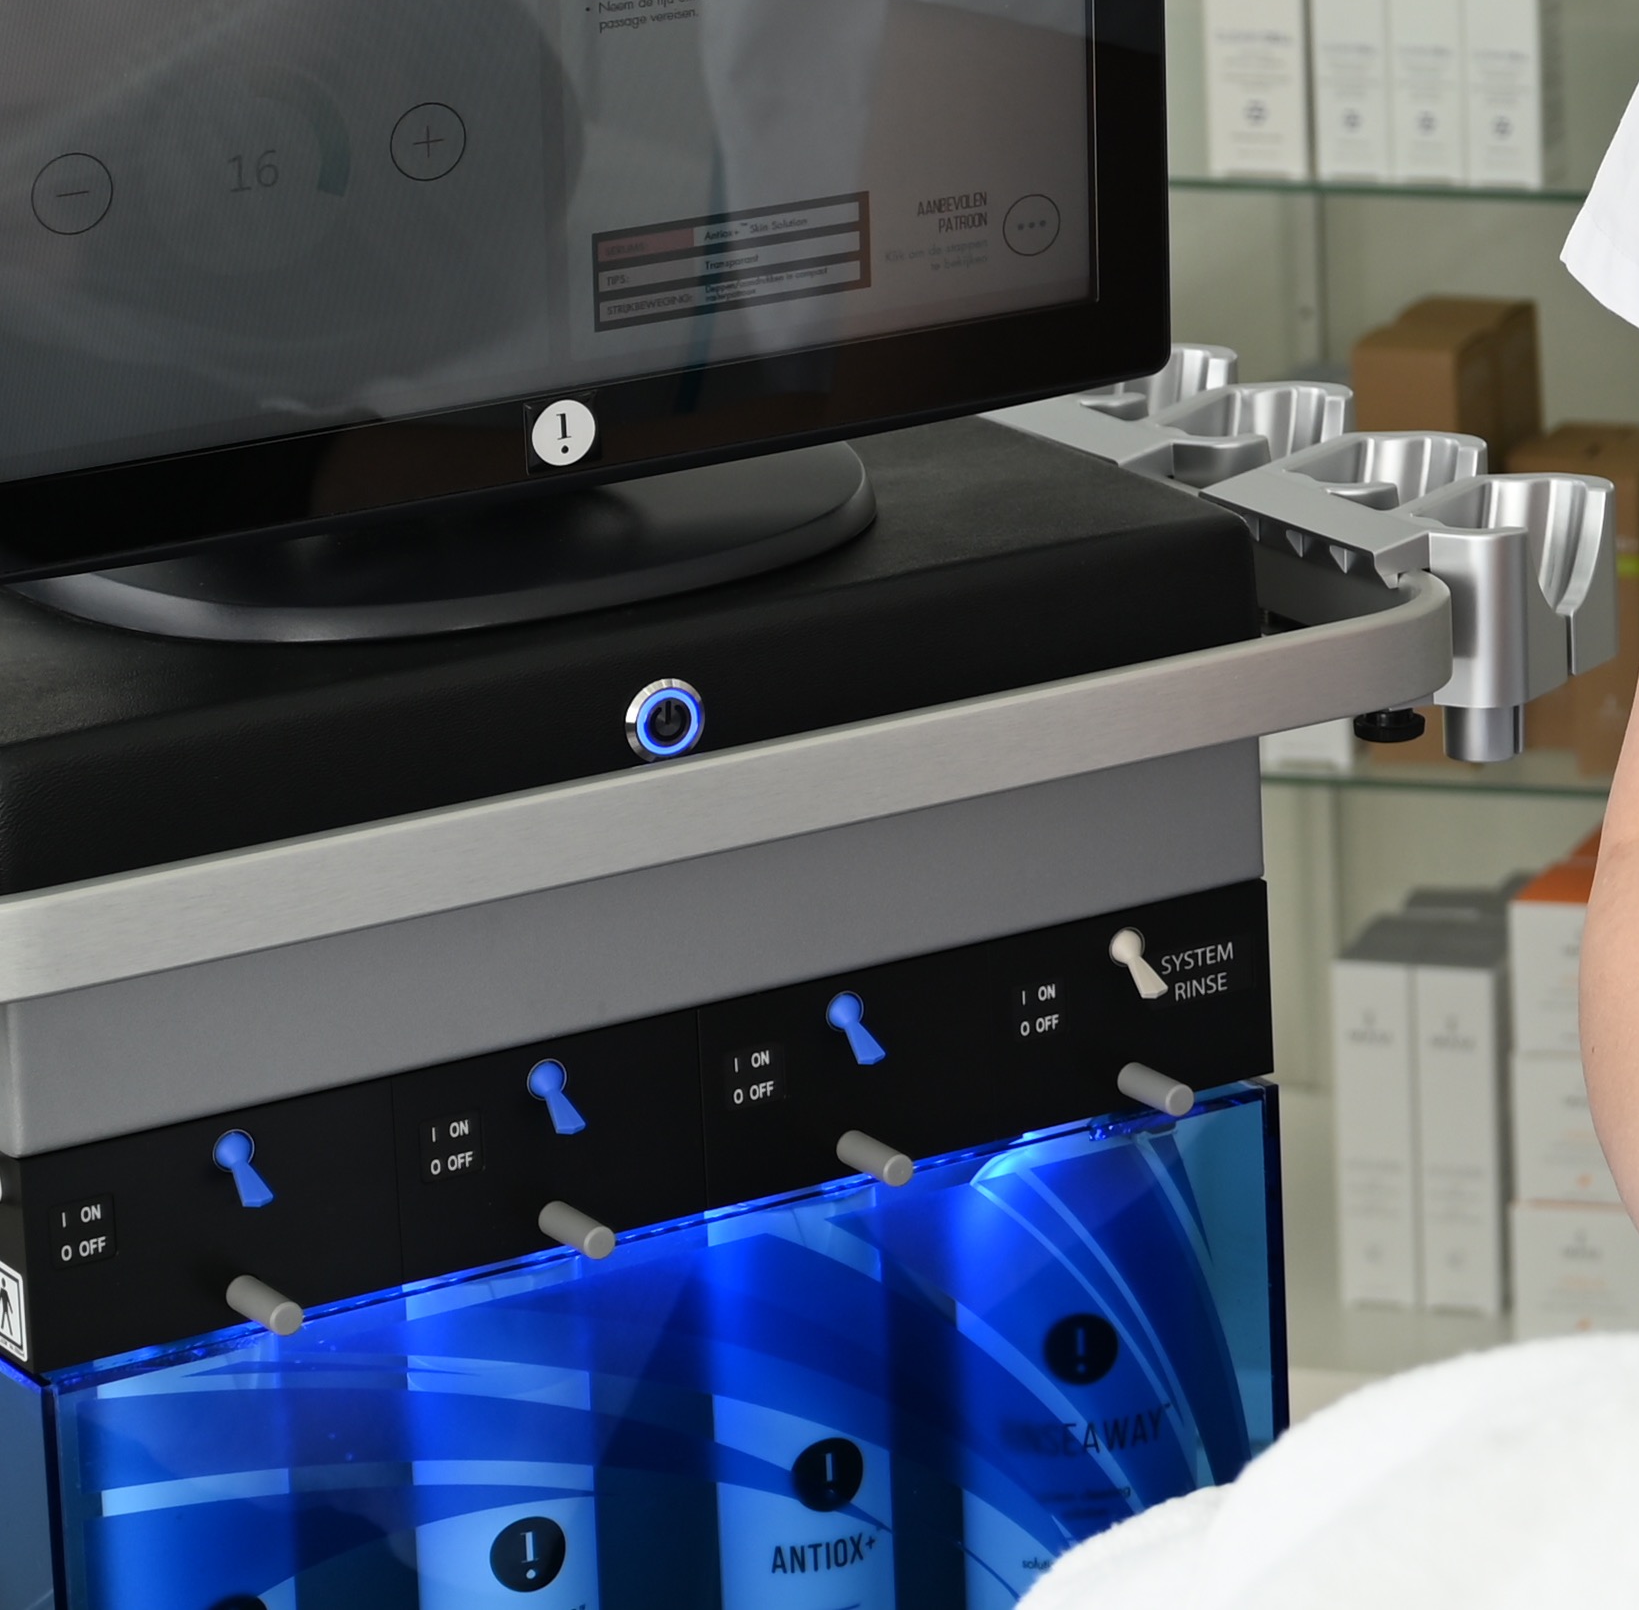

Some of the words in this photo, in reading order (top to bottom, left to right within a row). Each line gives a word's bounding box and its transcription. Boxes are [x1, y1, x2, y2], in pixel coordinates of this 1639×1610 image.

[598, 0, 634, 15] Neem
[599, 16, 647, 33] passage
[228, 149, 280, 193] 16
[917, 192, 988, 217] AANBEVOLEN
[938, 212, 988, 234] PATROON
[1161, 941, 1233, 975] SYSTEM
[1038, 984, 1056, 1001] ON
[1174, 972, 1228, 1001] RINSE
[1035, 1014, 1059, 1034] OFF
[751, 1050, 770, 1068] ON
[749, 1081, 774, 1101] OFF
[449, 1119, 469, 1139] ON
[447, 1151, 474, 1171] OFF
[80, 1204, 102, 1223] ON
[79, 1236, 106, 1257] OFF
[771, 1532, 876, 1574] ANTIOX+
